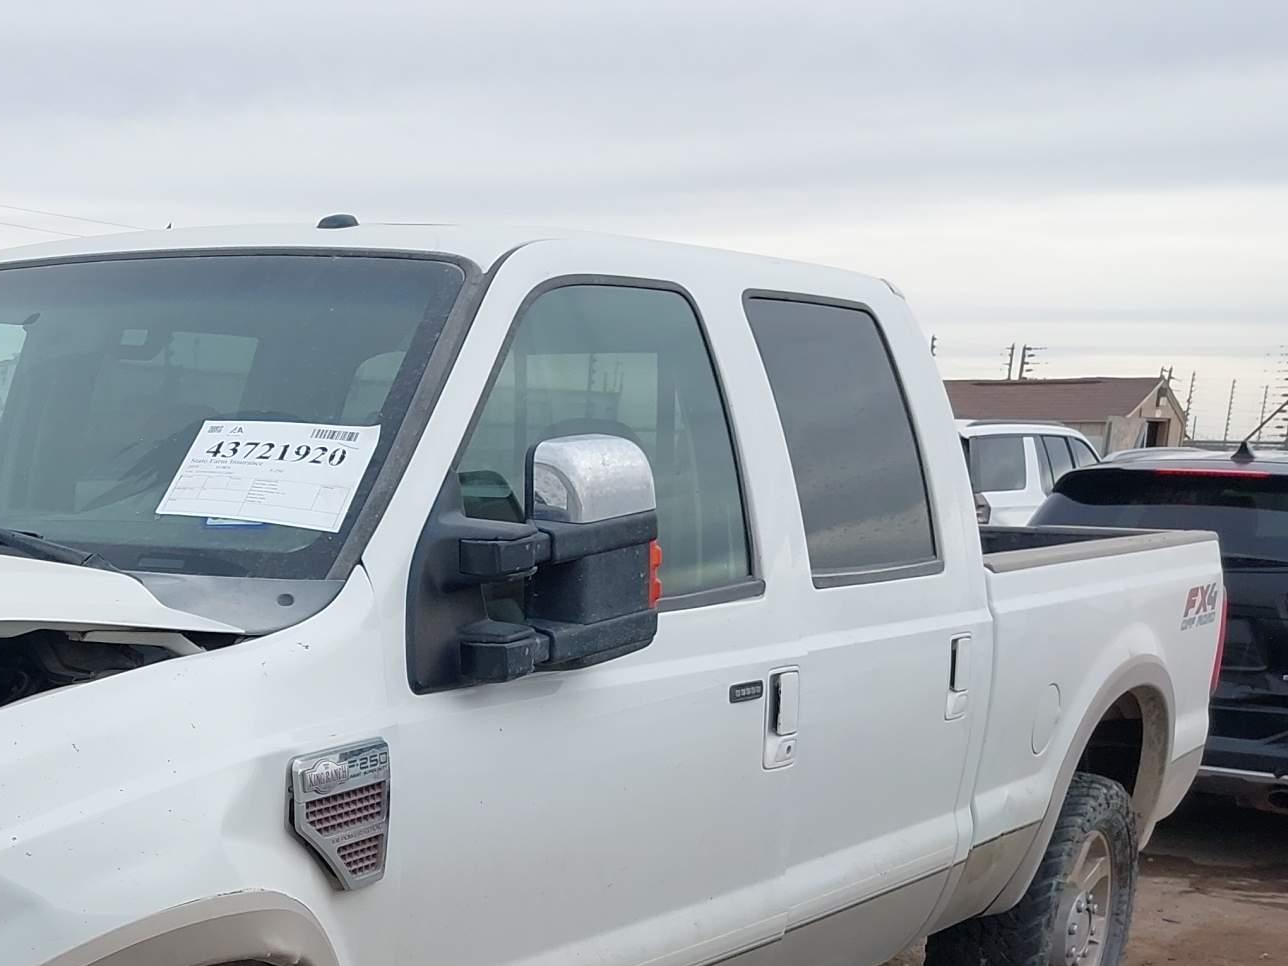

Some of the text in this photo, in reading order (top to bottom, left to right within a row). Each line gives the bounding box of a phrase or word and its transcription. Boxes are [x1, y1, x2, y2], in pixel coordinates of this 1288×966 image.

[206, 440, 347, 467] 43721920
[1183, 582, 1218, 618] FX4
[348, 752, 388, 770] F-250
